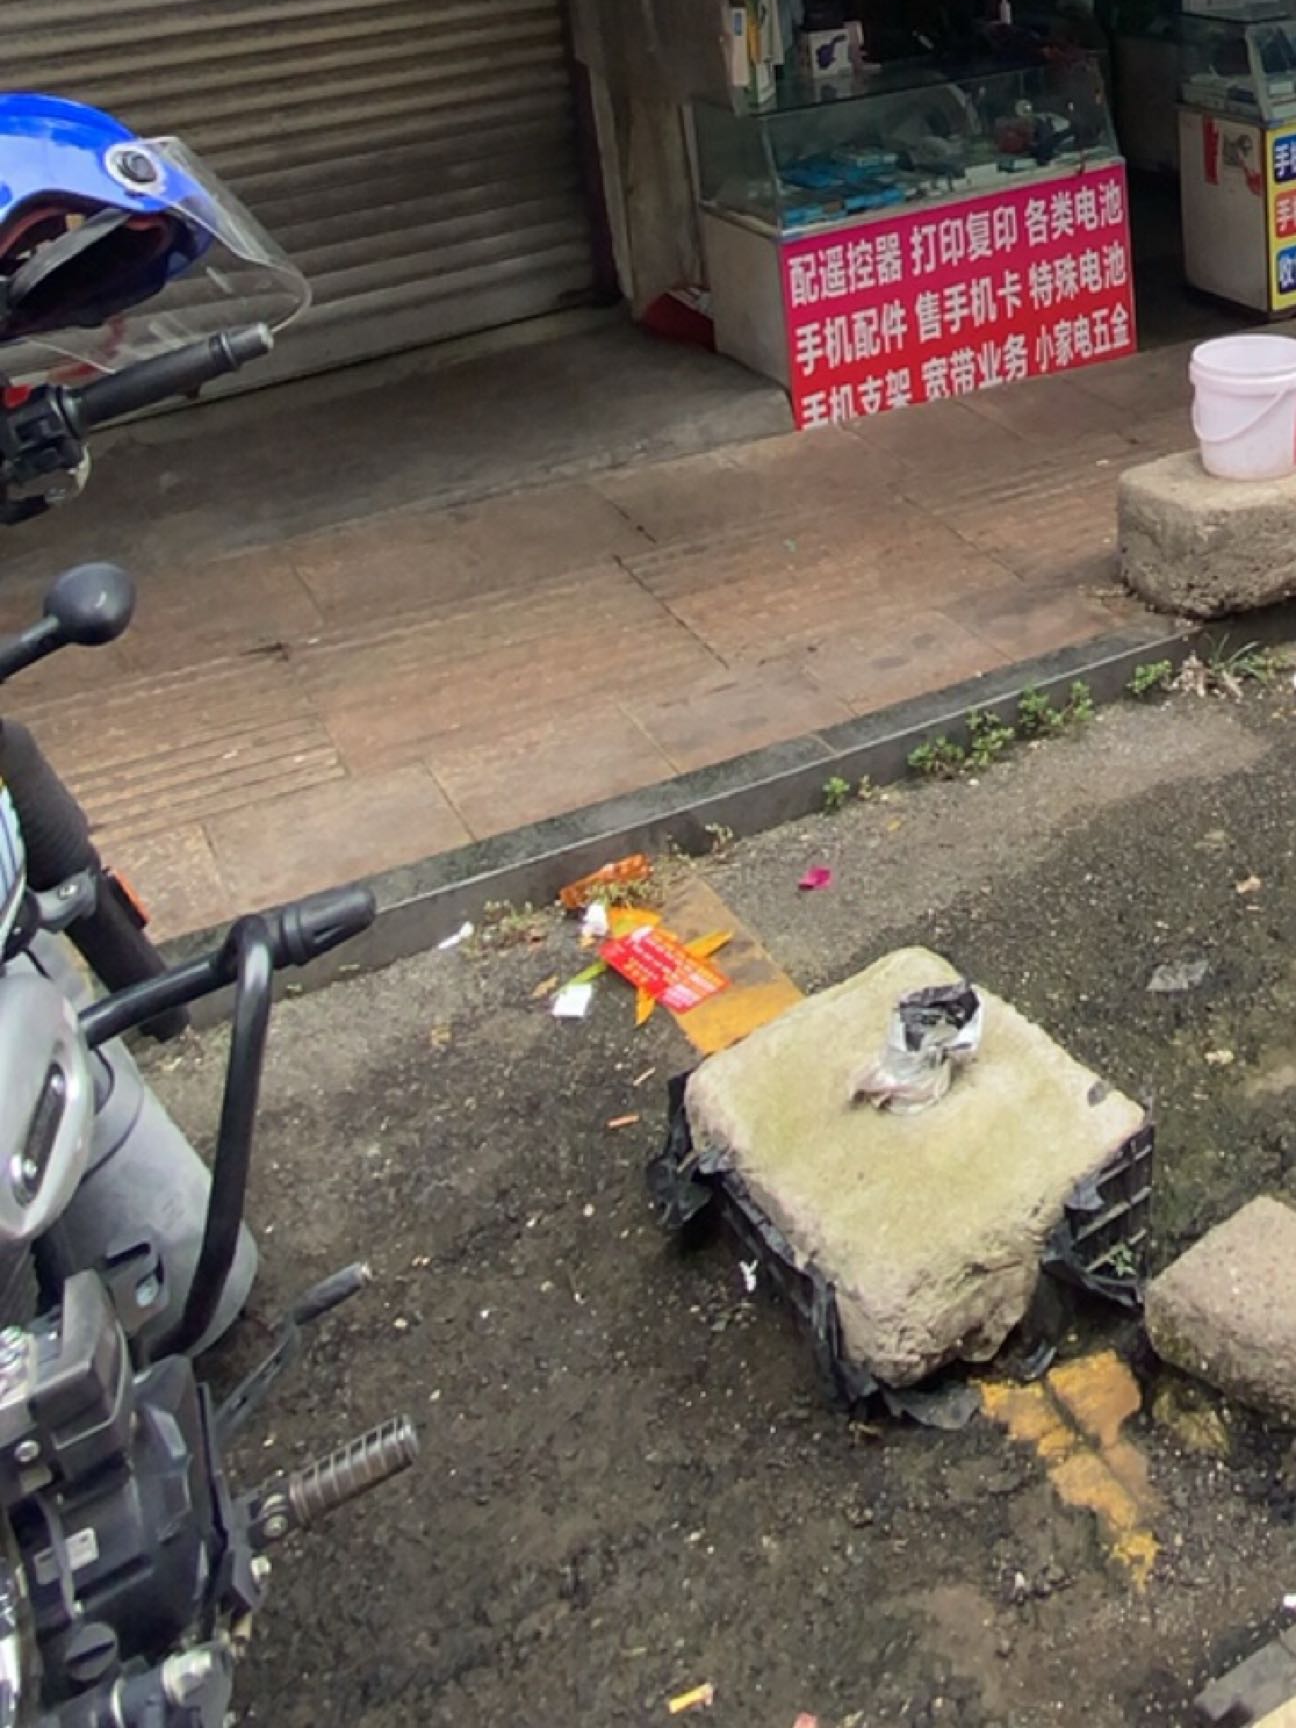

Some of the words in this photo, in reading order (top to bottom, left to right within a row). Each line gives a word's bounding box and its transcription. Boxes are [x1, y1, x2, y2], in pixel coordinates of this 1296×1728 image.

[788, 232, 902, 308] 配遥控器
[910, 205, 1018, 276] 打印复印
[1025, 179, 1124, 246] 各类电池
[796, 299, 907, 376] 手机配件
[916, 271, 1023, 343] 售手机卡
[1029, 241, 1128, 309] 特殊电池
[802, 370, 913, 430] 手机支架
[922, 334, 1029, 402] 宽带业务
[1034, 302, 1131, 373] 小家电五金
